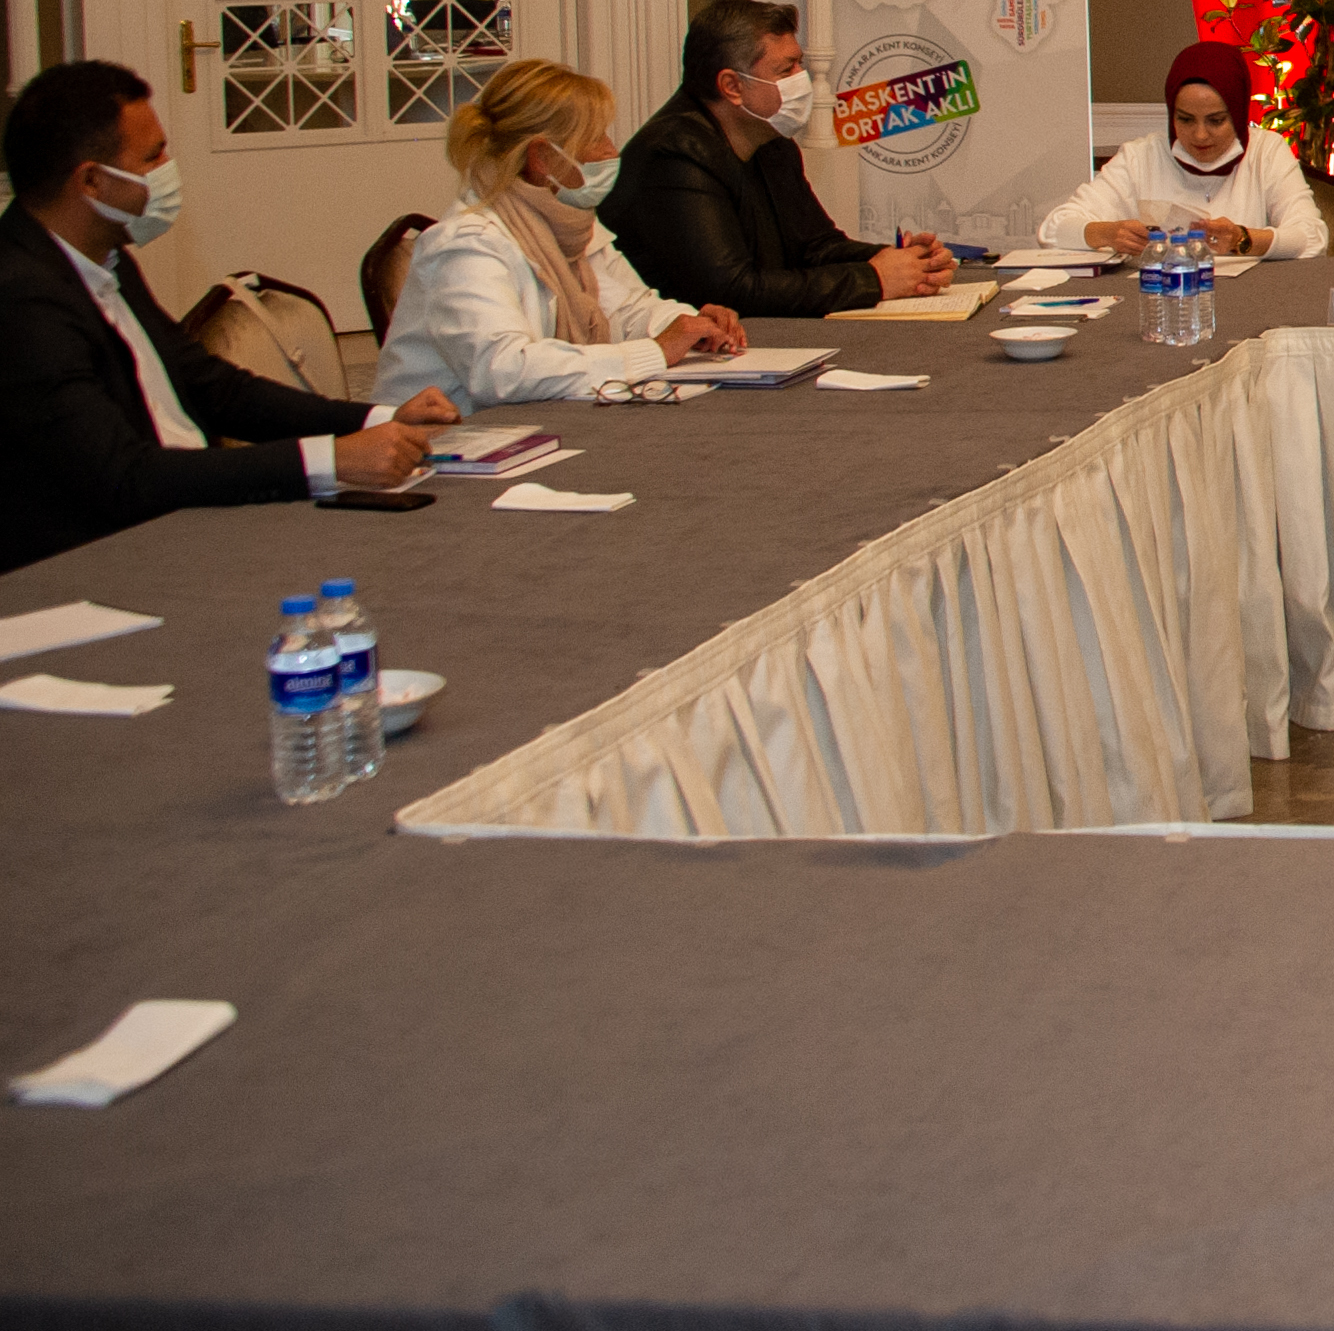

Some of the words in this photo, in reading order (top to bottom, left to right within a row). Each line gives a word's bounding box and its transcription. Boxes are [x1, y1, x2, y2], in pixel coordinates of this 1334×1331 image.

[846, 50, 877, 87] ANKARA
[875, 41, 900, 54] KENT
[842, 105, 919, 141] ORTAK
[926, 90, 975, 120] AKLI
[862, 146, 902, 166] ANKARA
[904, 153, 931, 166] KENT
